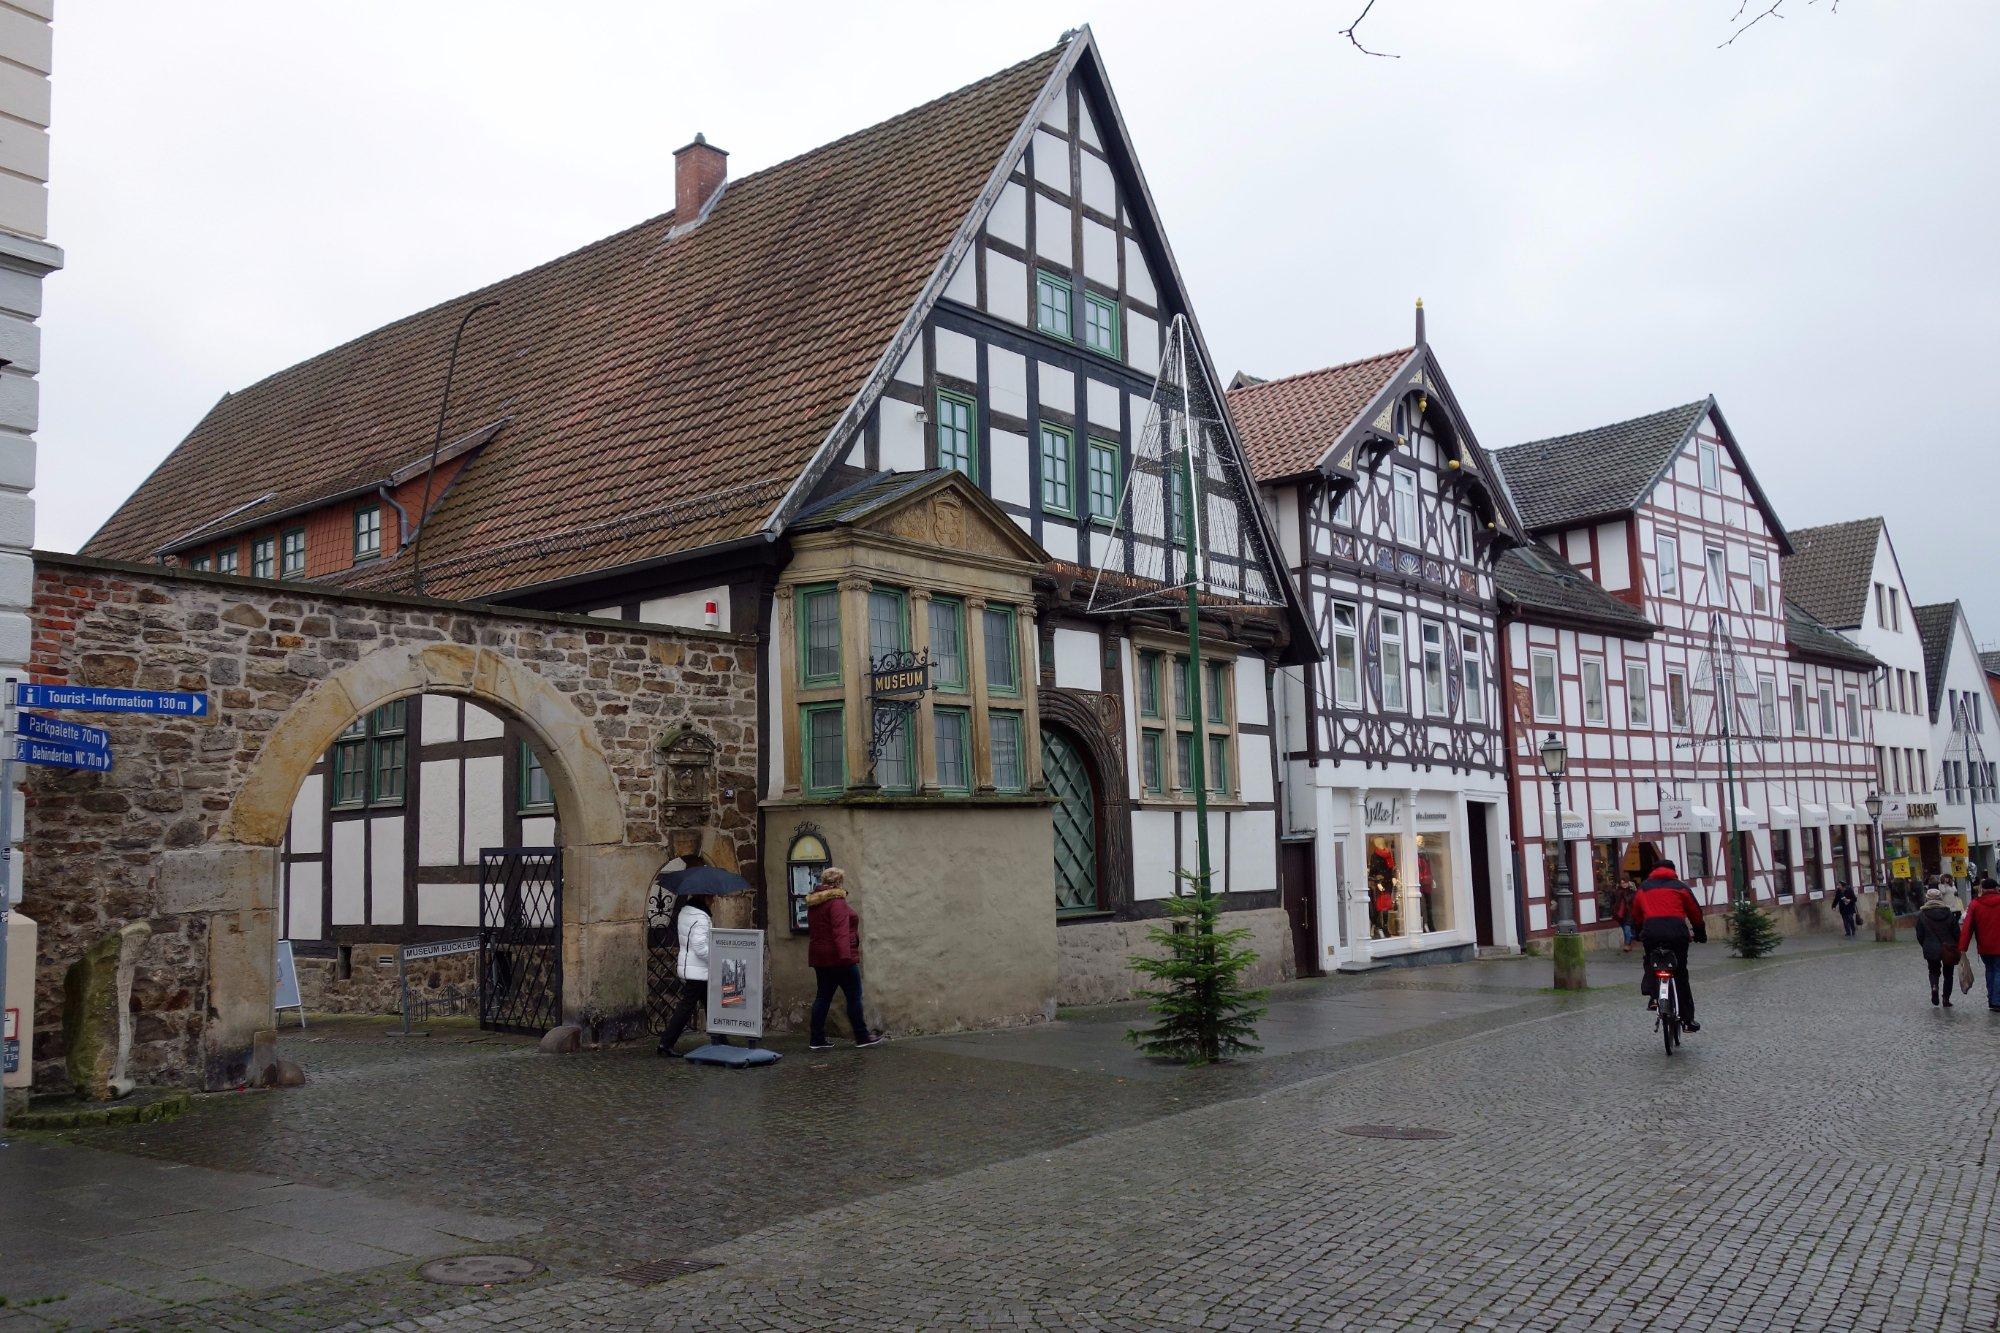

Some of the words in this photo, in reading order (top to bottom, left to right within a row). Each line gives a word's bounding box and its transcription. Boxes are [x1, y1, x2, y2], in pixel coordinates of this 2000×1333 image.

[875, 670, 923, 692] MUSEUM
[48, 690, 153, 709] Tourist-Information
[158, 696, 175, 710] 130
[177, 701, 187, 710] m
[29, 716, 79, 740] Parkpalette
[32, 745, 73, 763] Behinderten
[75, 750, 85, 765] WC
[406, 945, 440, 957] MUSEUM
[715, 939, 731, 947] MUSEUM
[713, 1018, 737, 1026] EINTRITT
